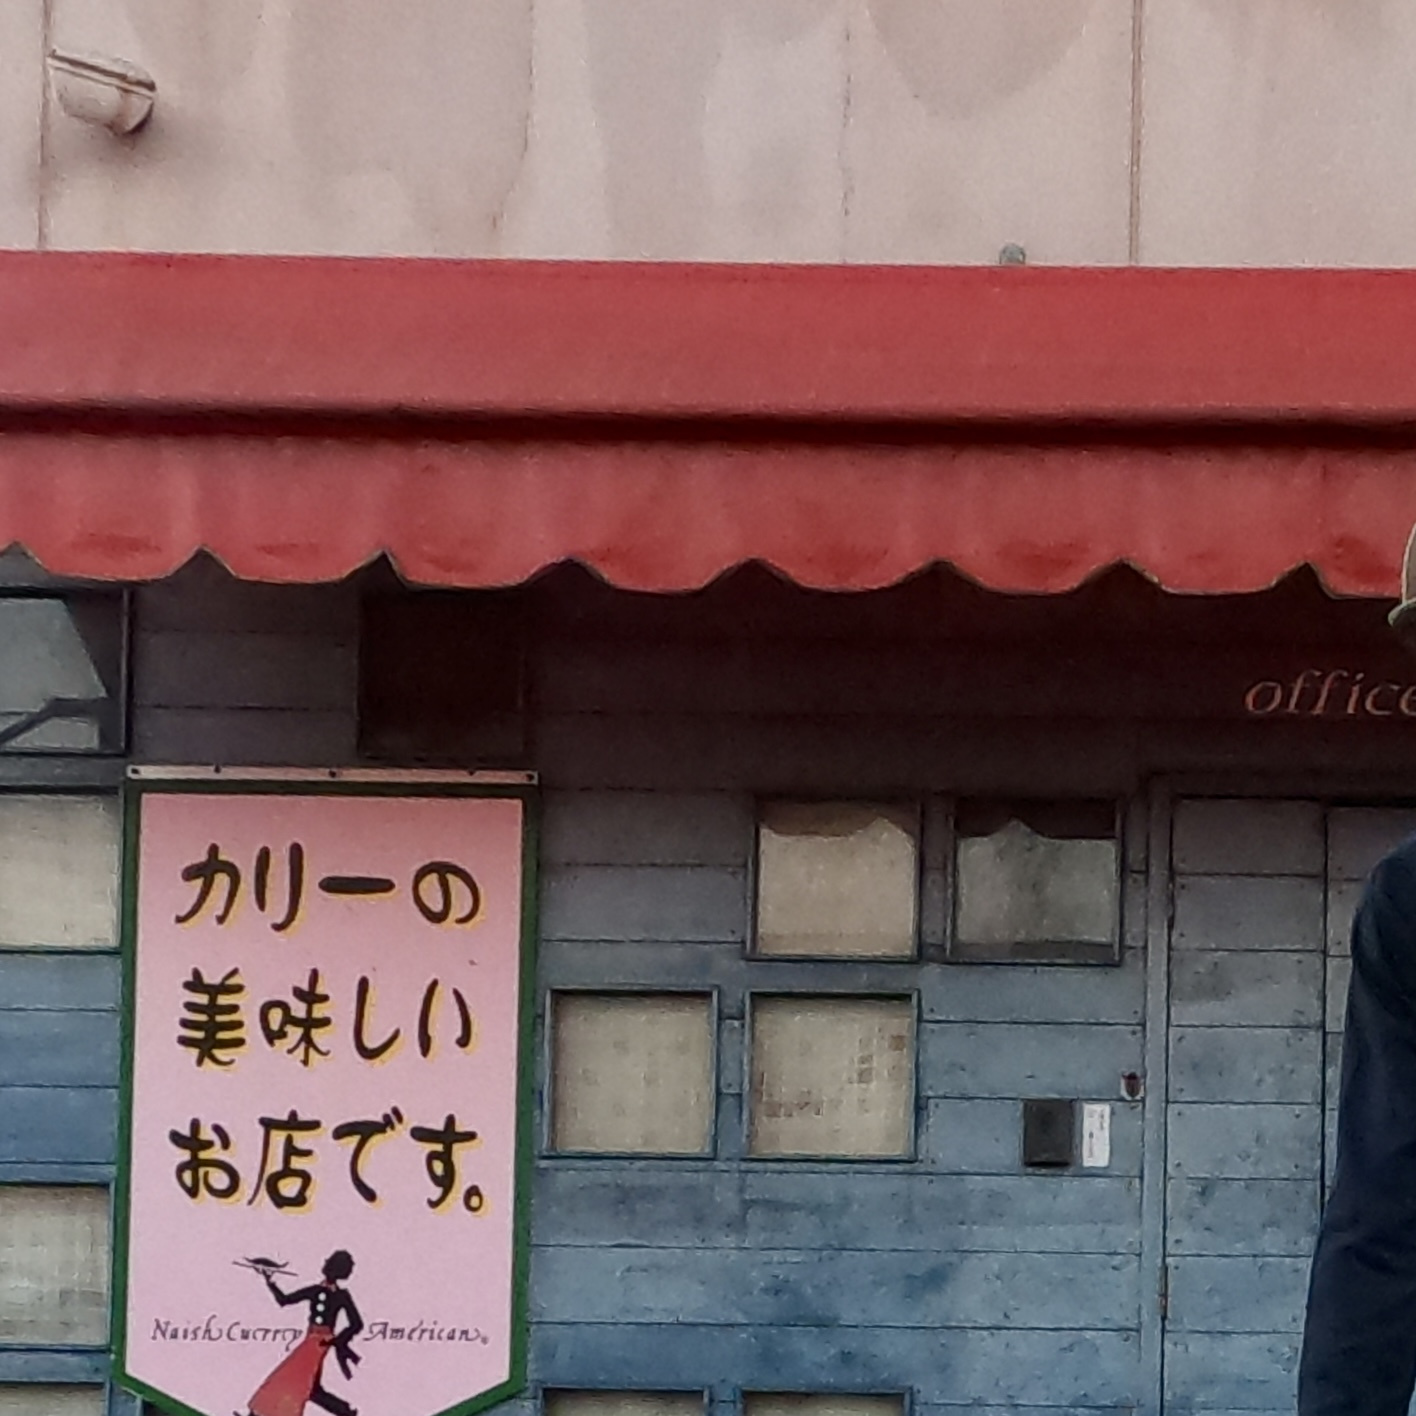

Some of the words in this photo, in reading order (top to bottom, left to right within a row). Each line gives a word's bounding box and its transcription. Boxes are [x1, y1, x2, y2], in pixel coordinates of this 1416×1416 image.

[175, 841, 483, 932] カリーの
[176, 967, 474, 1067] 美味しい
[168, 1106, 484, 1213] お店です。
[150, 1313, 224, 1342] Naish
